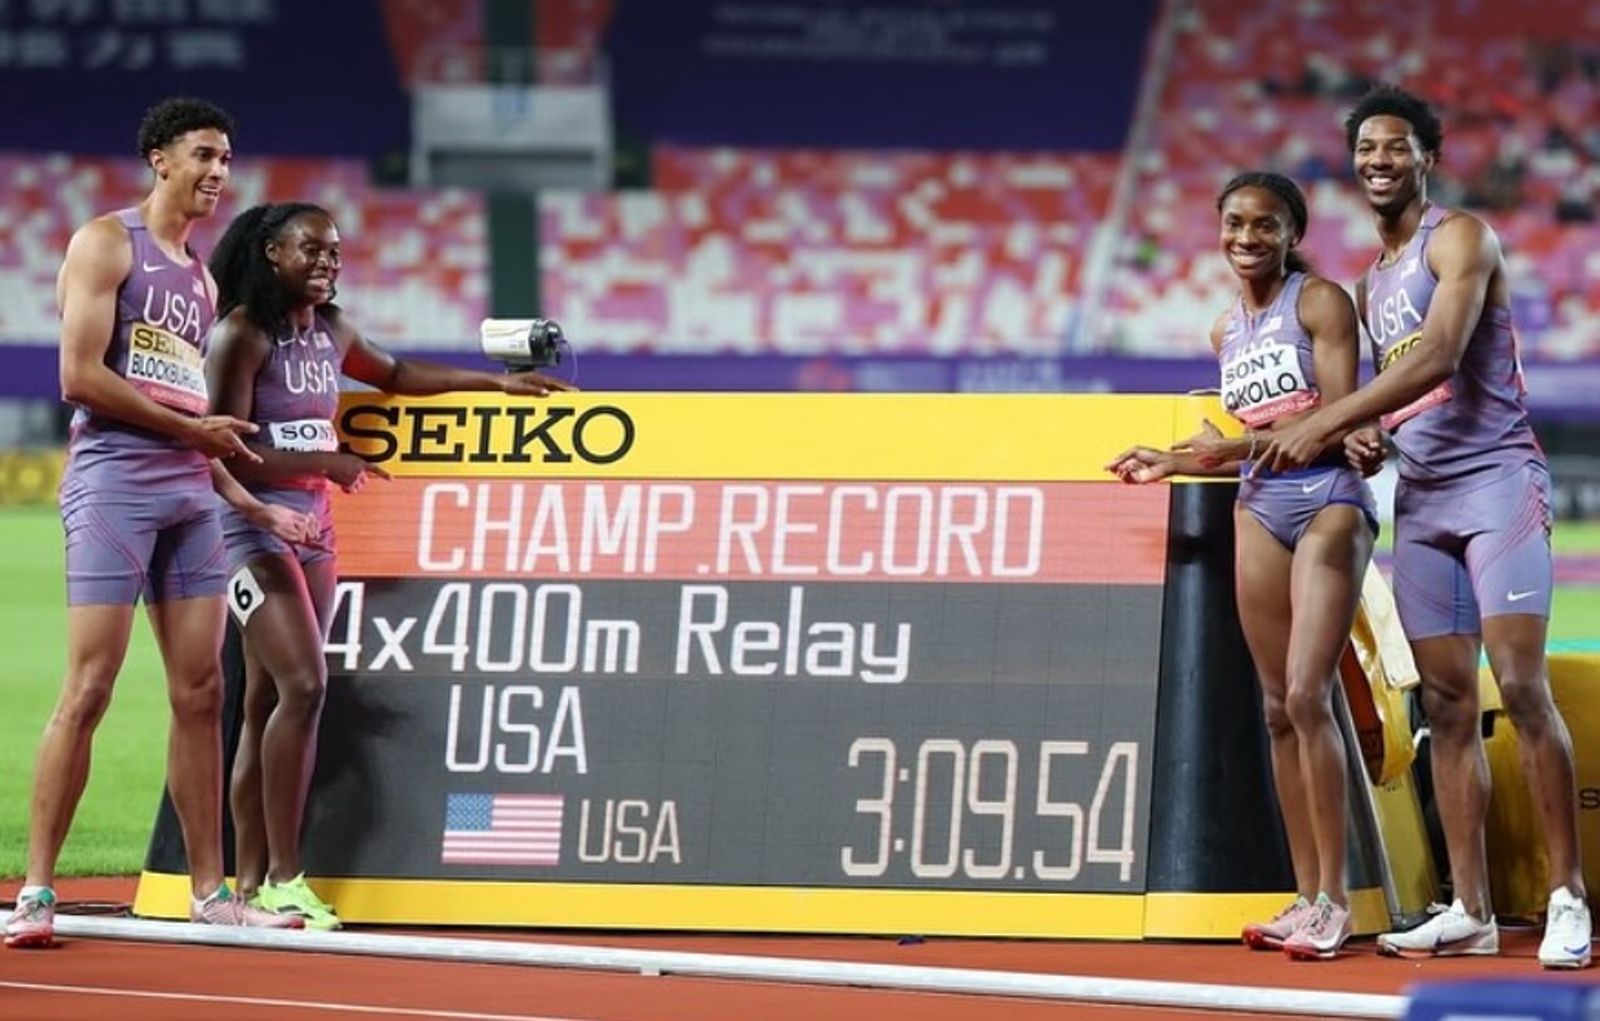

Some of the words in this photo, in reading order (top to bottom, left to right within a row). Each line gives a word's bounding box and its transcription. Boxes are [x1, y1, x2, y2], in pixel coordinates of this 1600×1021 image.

[143, 285, 201, 342] USA
[1368, 287, 1423, 345] USA
[284, 359, 339, 394] USA
[1225, 349, 1285, 385] SONY
[1225, 372, 1298, 410] OKOLO
[339, 405, 635, 464] SEIKO
[234, 580, 253, 612] 6
[323, 582, 641, 674] 4x400m
[675, 585, 911, 683] Relay
[445, 684, 588, 774] USA
[577, 798, 682, 864] USA
[841, 737, 1139, 881] 3:09.54
